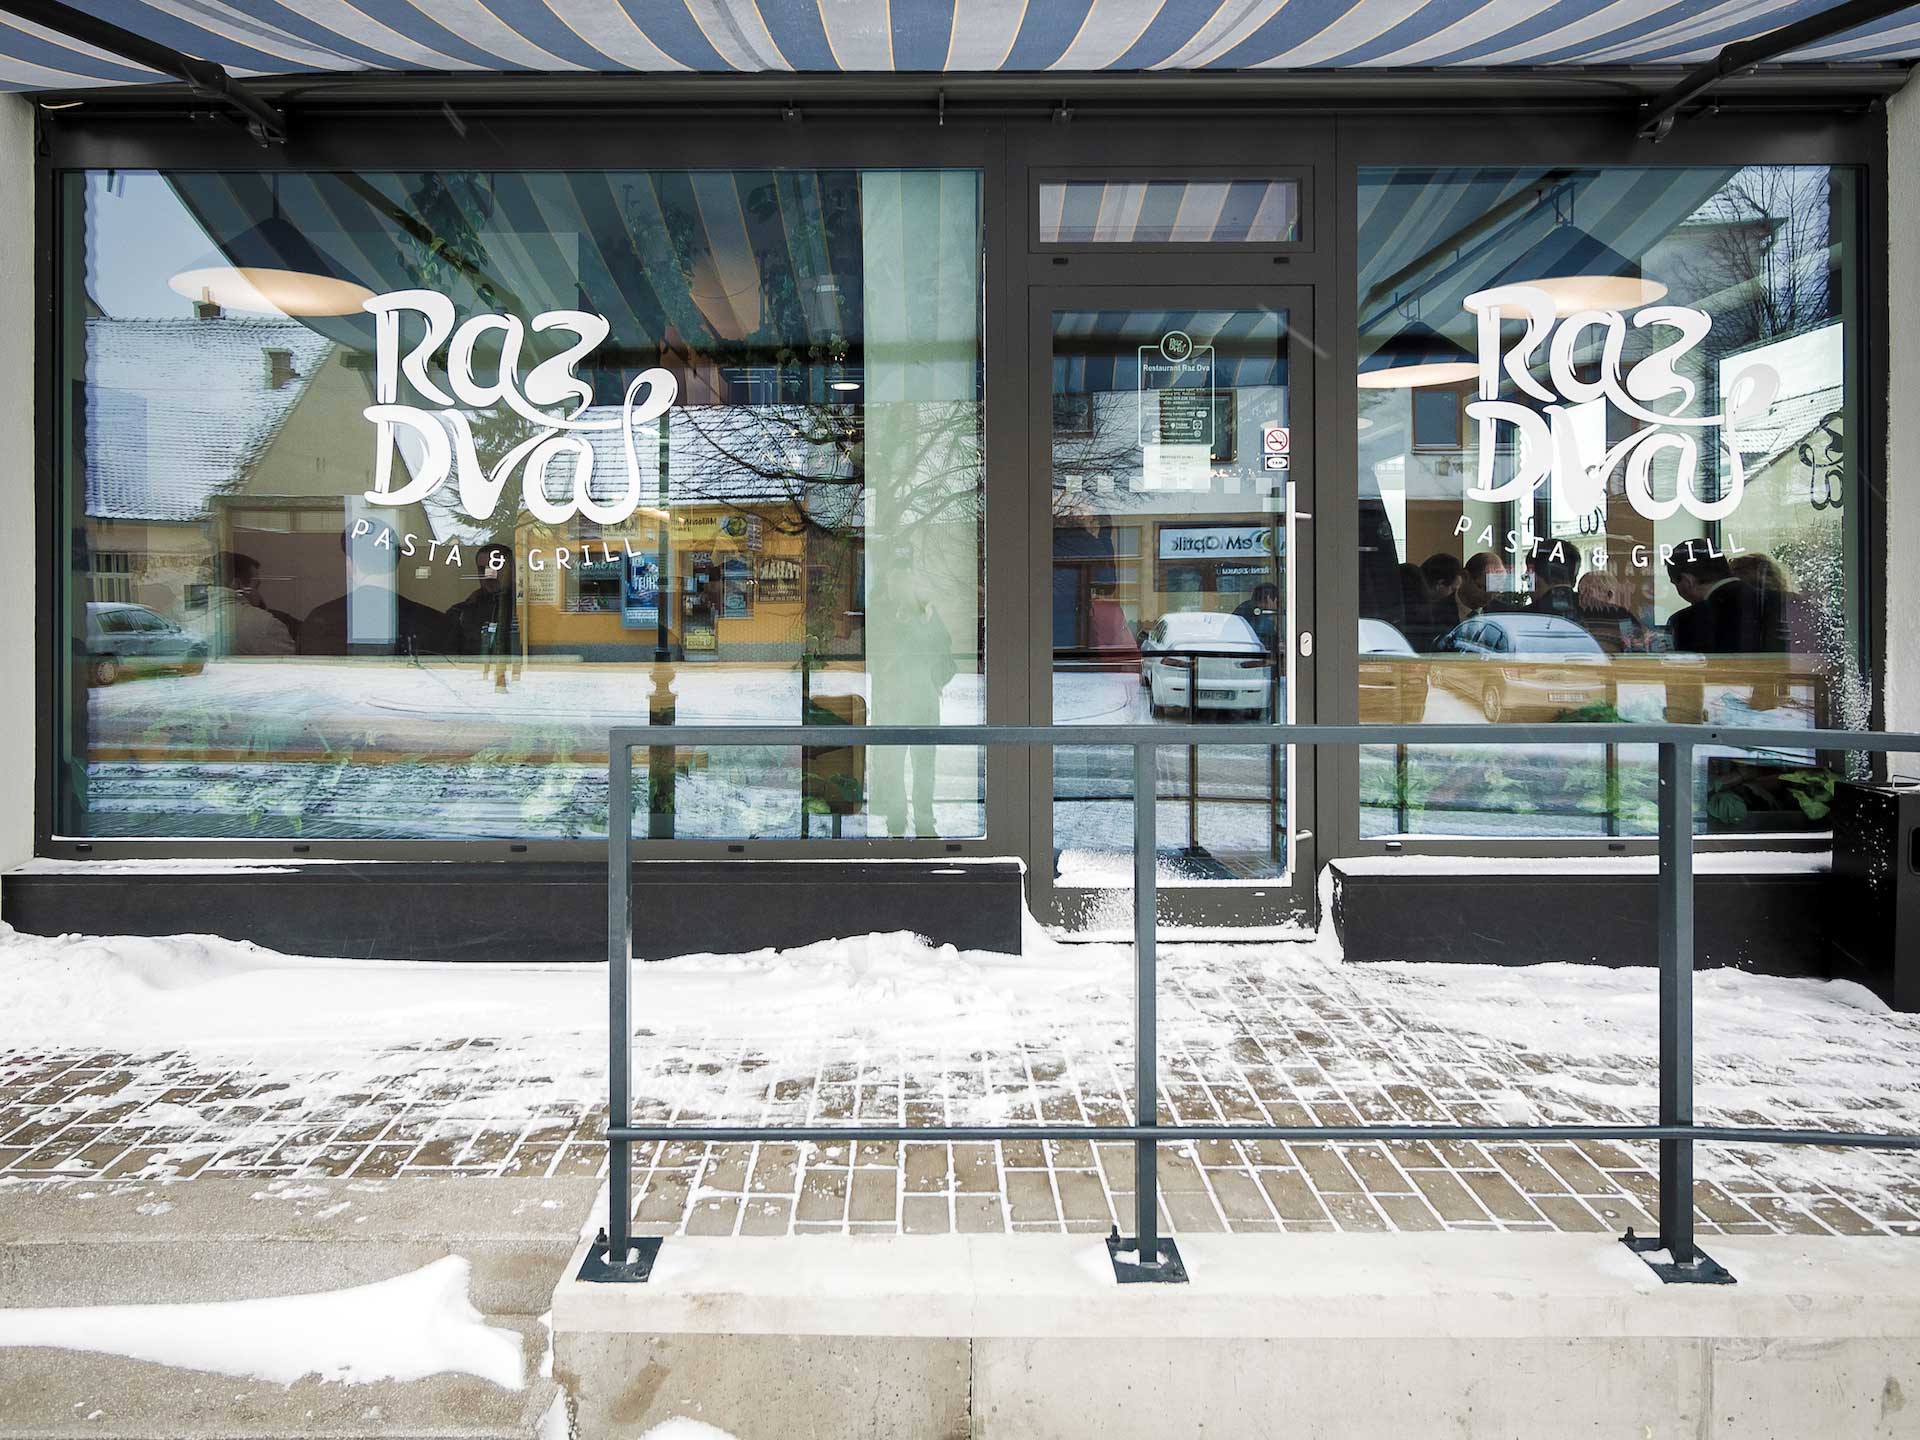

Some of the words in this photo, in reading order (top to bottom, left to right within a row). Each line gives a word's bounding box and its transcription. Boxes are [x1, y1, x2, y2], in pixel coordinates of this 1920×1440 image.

[363, 289, 611, 430] Raz
[1143, 364, 1180, 372] Restaurant
[1182, 364, 1195, 372] Raz
[1196, 364, 1211, 372] Dva
[1463, 286, 1712, 427] Raz
[351, 518, 462, 568] PASTA
[488, 549, 506, 571] &
[528, 537, 642, 571] GRILL
[1454, 514, 1566, 564] PASTA
[1591, 545, 1609, 567] &
[1631, 533, 1747, 569] GRILL
